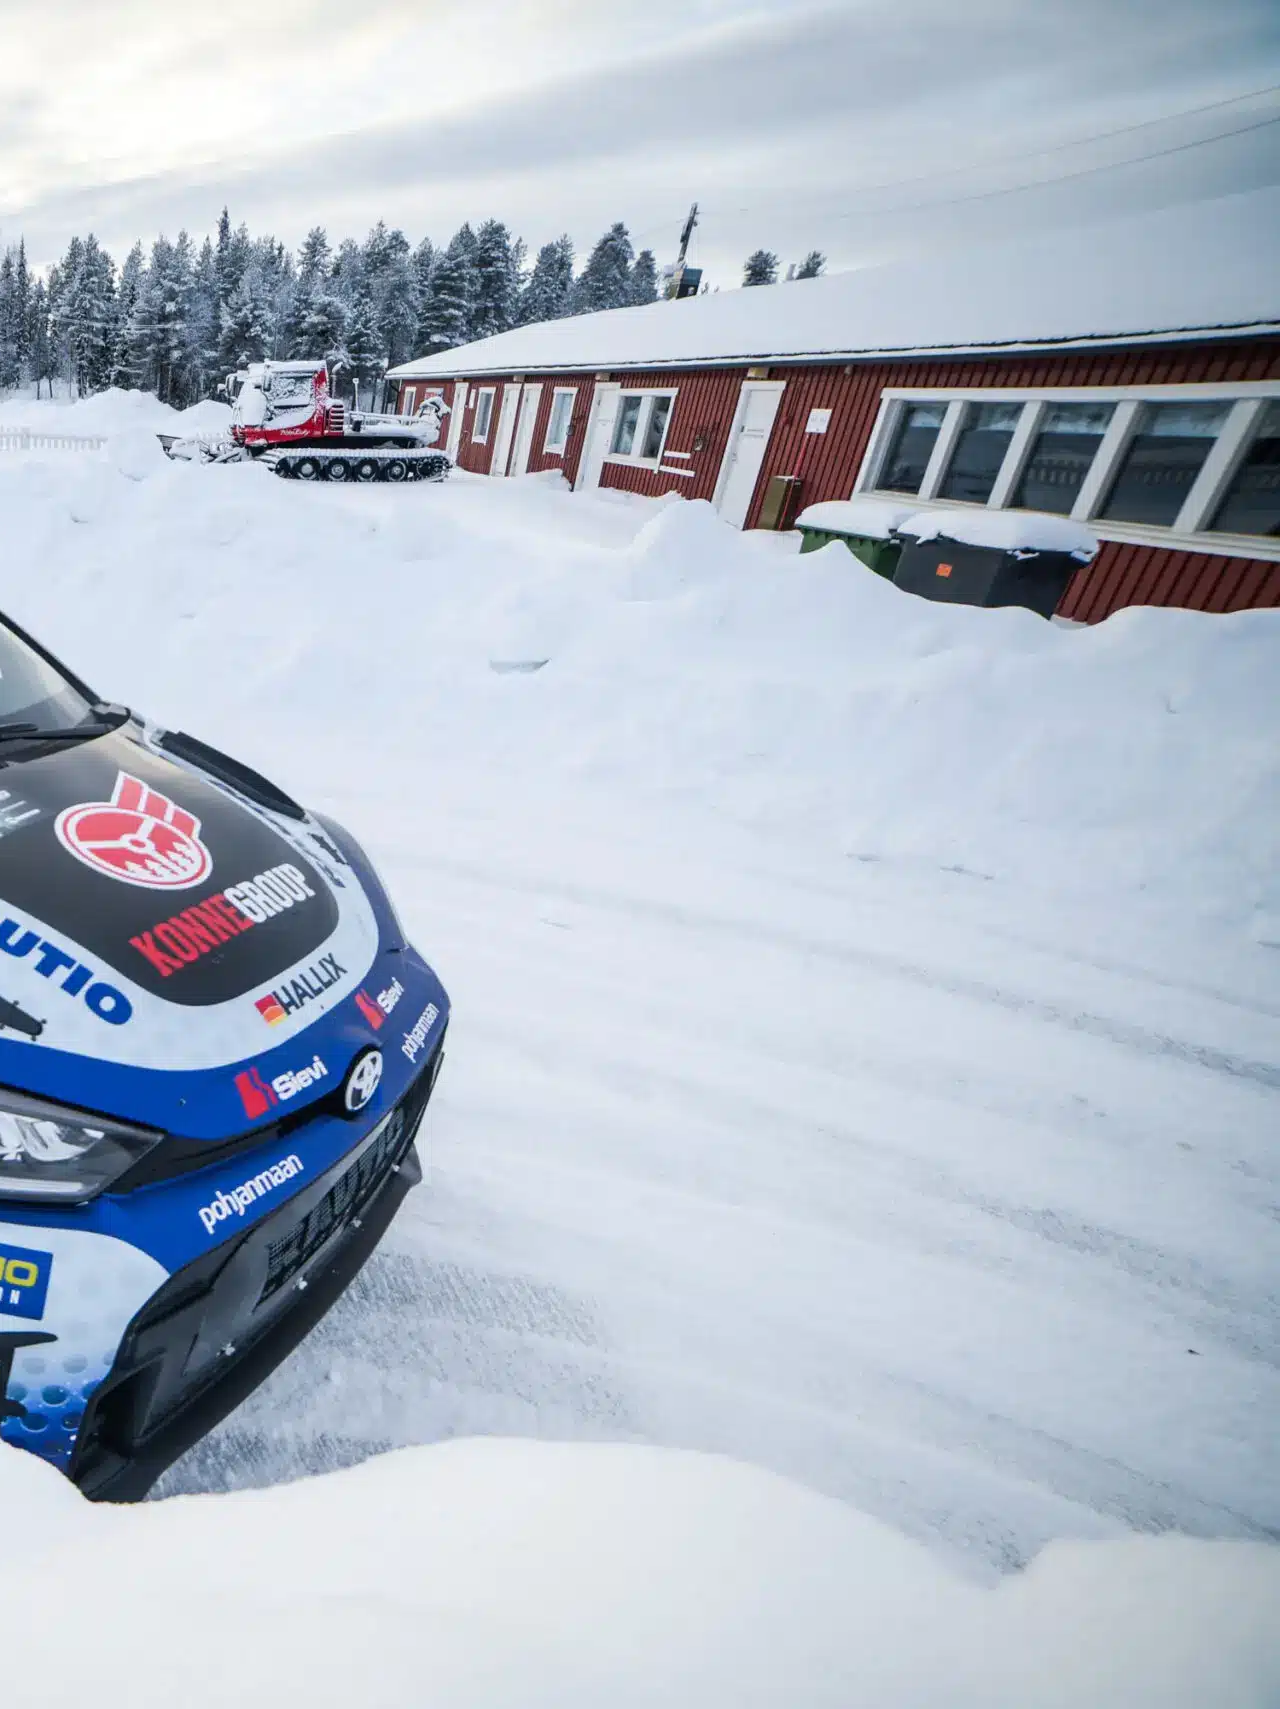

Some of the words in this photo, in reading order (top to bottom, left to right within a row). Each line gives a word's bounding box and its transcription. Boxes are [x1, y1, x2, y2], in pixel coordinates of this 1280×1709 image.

[272, 952, 348, 1015] HALLIX
[376, 976, 405, 1014] Sievi
[402, 1003, 440, 1063] pohjanmaan
[272, 1055, 329, 1101] Sievi
[198, 1154, 304, 1235] pohjanmaan
